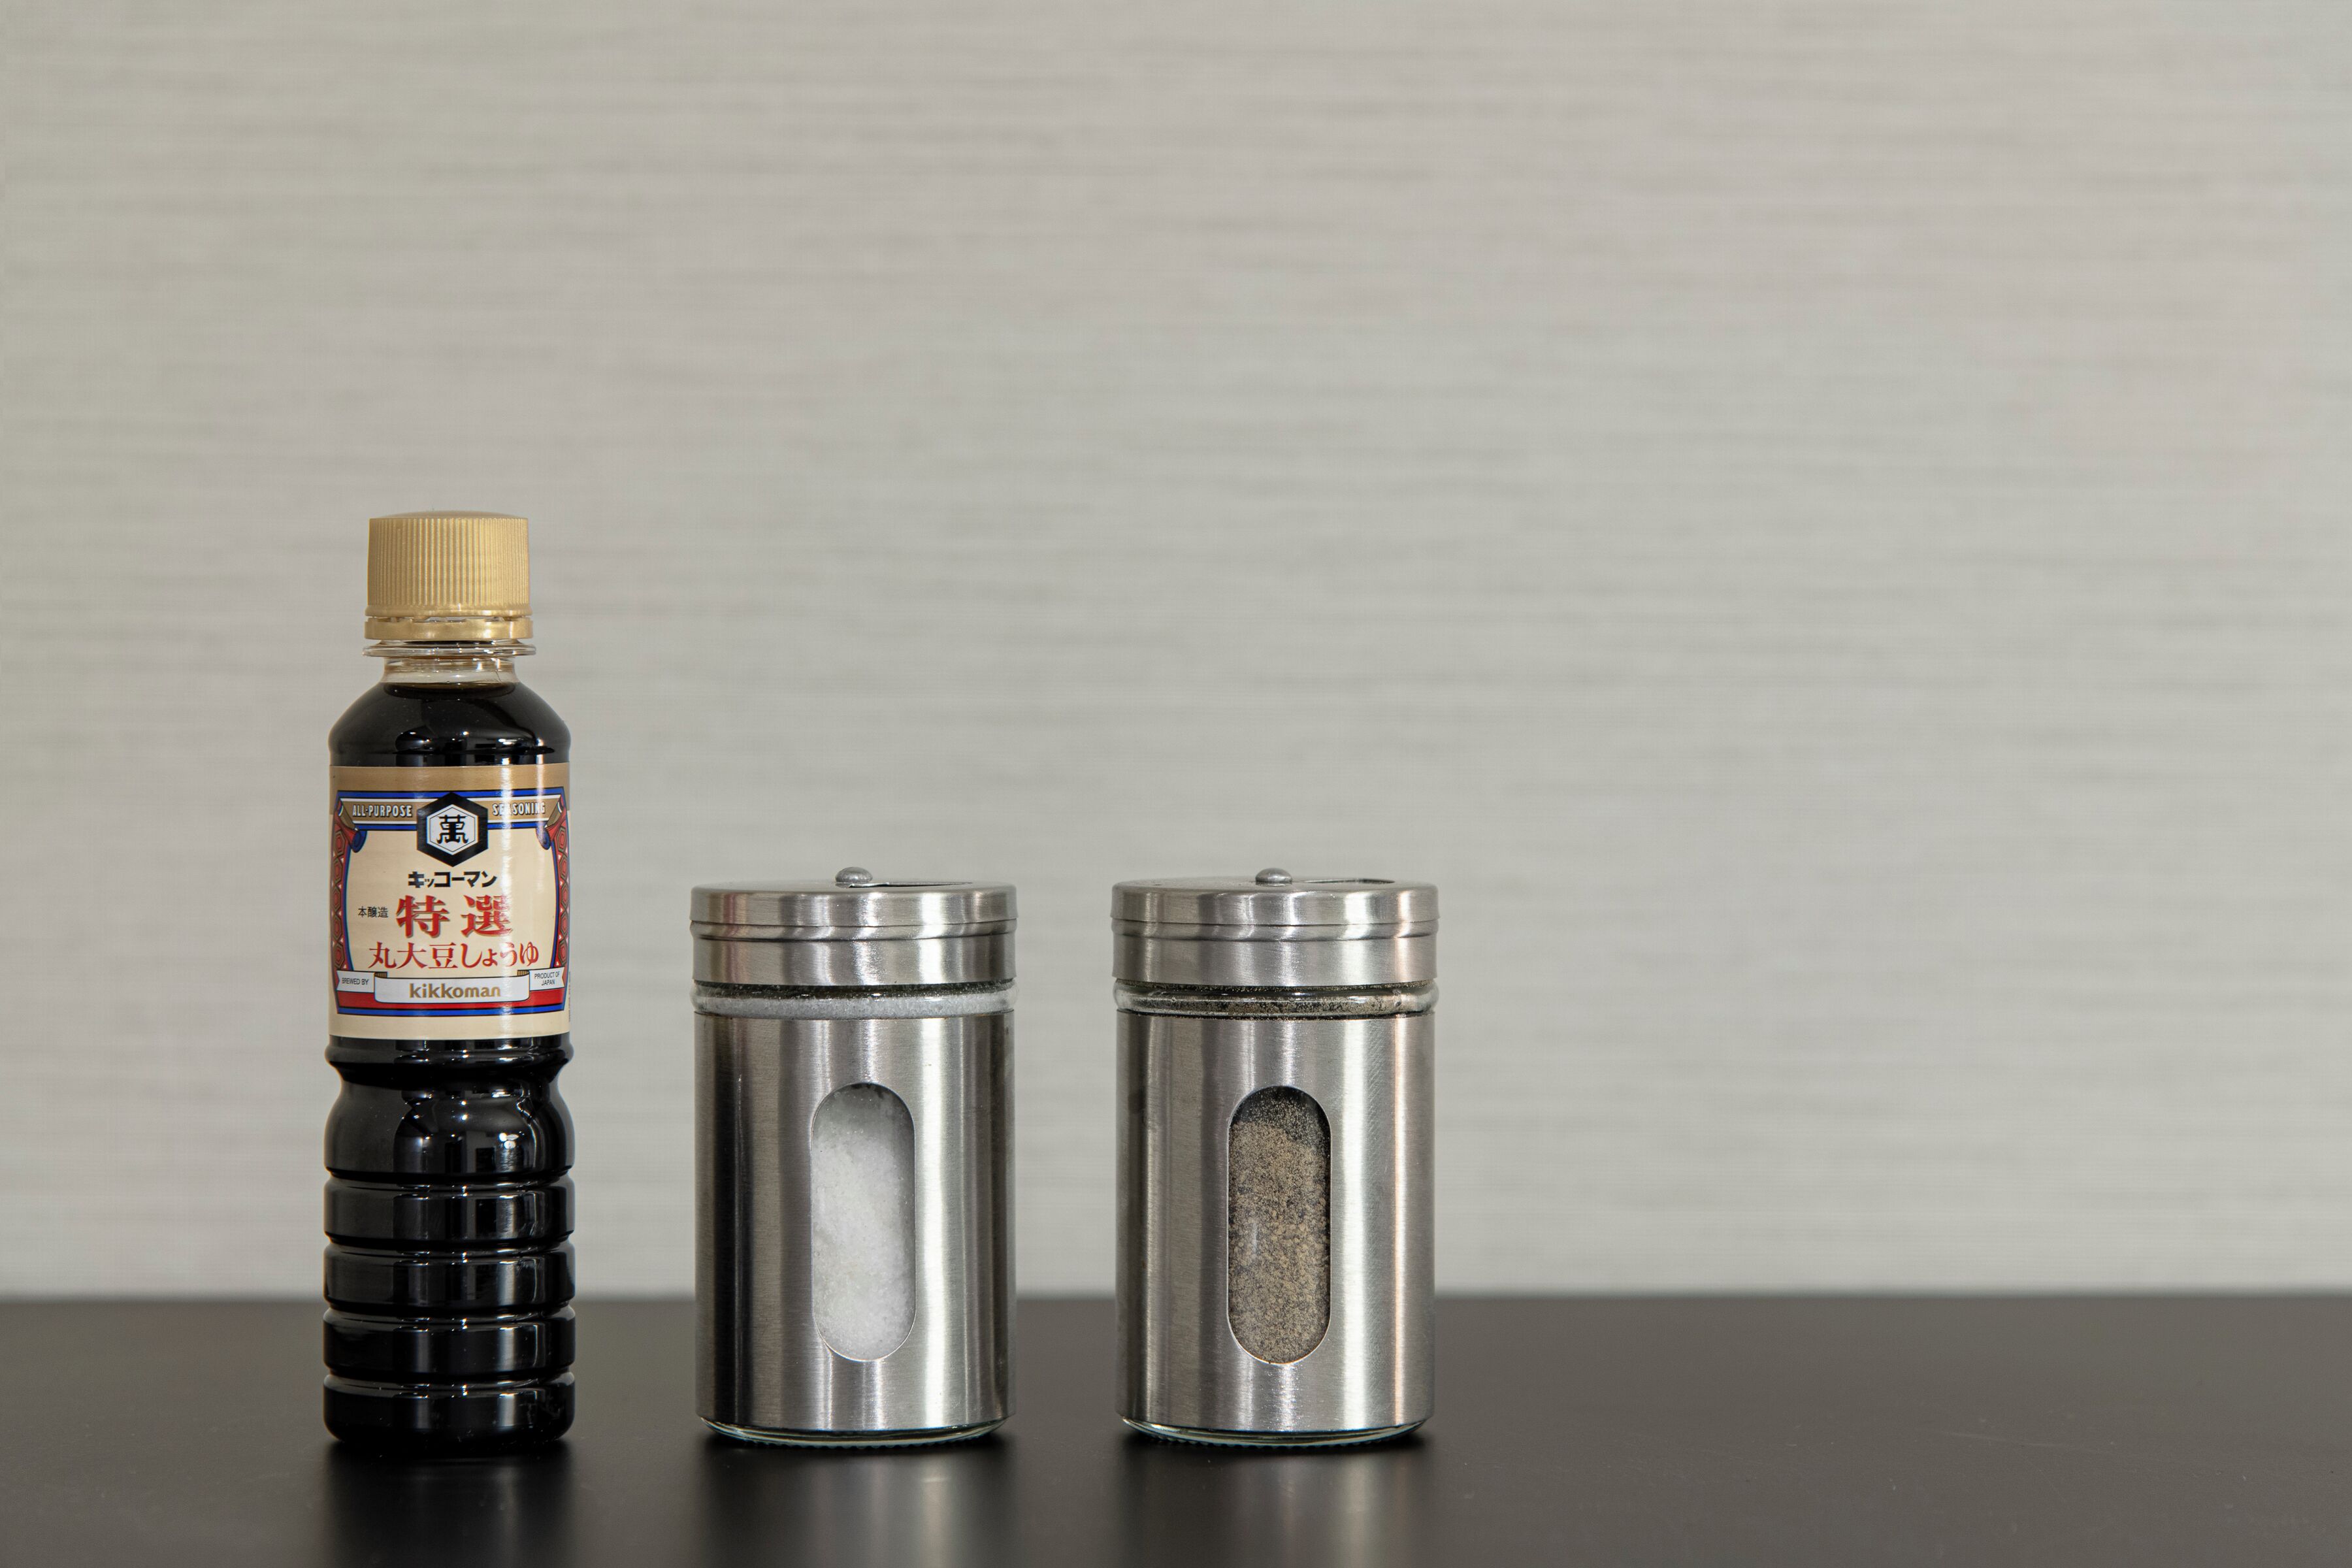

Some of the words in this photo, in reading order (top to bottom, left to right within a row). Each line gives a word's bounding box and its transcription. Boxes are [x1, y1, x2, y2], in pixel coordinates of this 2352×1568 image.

[352, 804, 413, 818] ALL-PURPOSE
[492, 802, 546, 816] SESONING
[408, 871, 497, 889] キッコーマン
[358, 906, 388, 918] 本醸造
[396, 894, 514, 938] 特選
[368, 941, 539, 969] 丸大豆しょうゆ
[534, 972, 555, 980] PRODUCT
[409, 983, 500, 998] kikkoman
